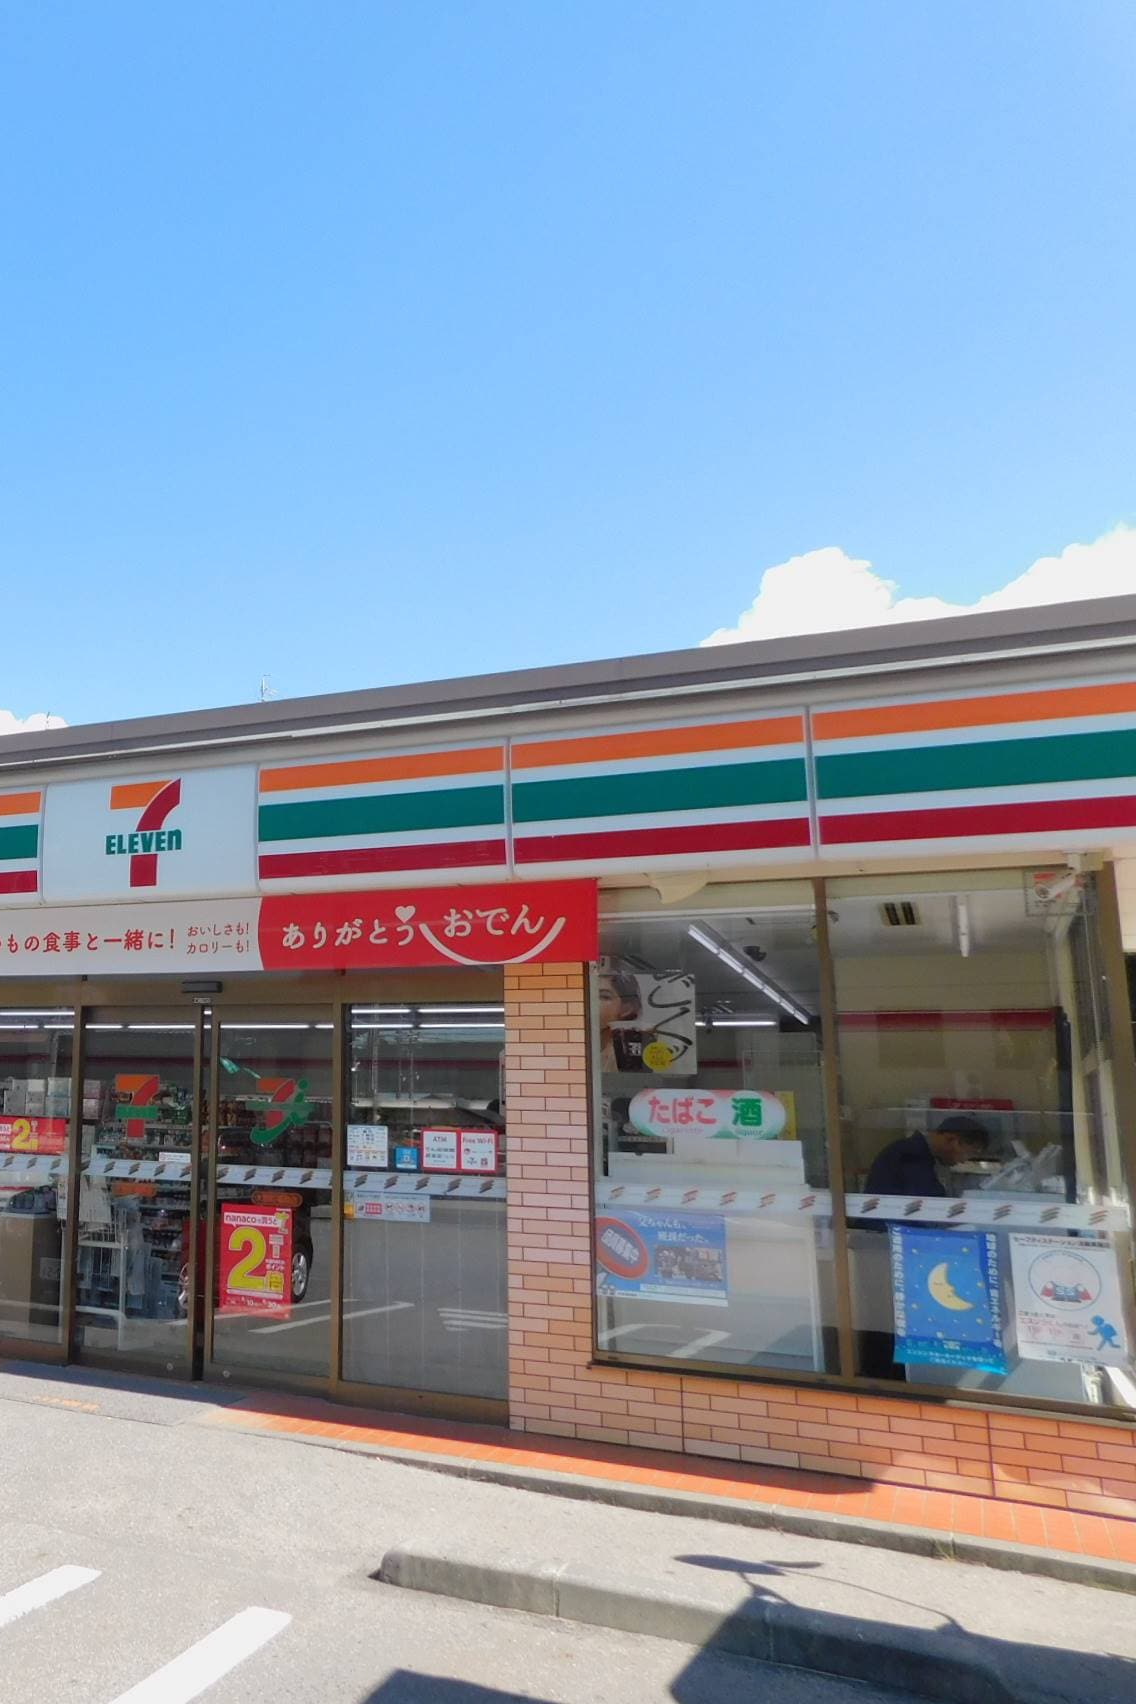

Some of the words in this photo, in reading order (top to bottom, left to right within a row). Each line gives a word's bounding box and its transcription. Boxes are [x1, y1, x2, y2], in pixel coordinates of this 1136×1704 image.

[282, 906, 416, 949] ありがとう
[443, 904, 545, 938] おでん
[649, 1096, 717, 1125] たばこ
[731, 1097, 762, 1126] 酒
[228, 1226, 266, 1291] 2
